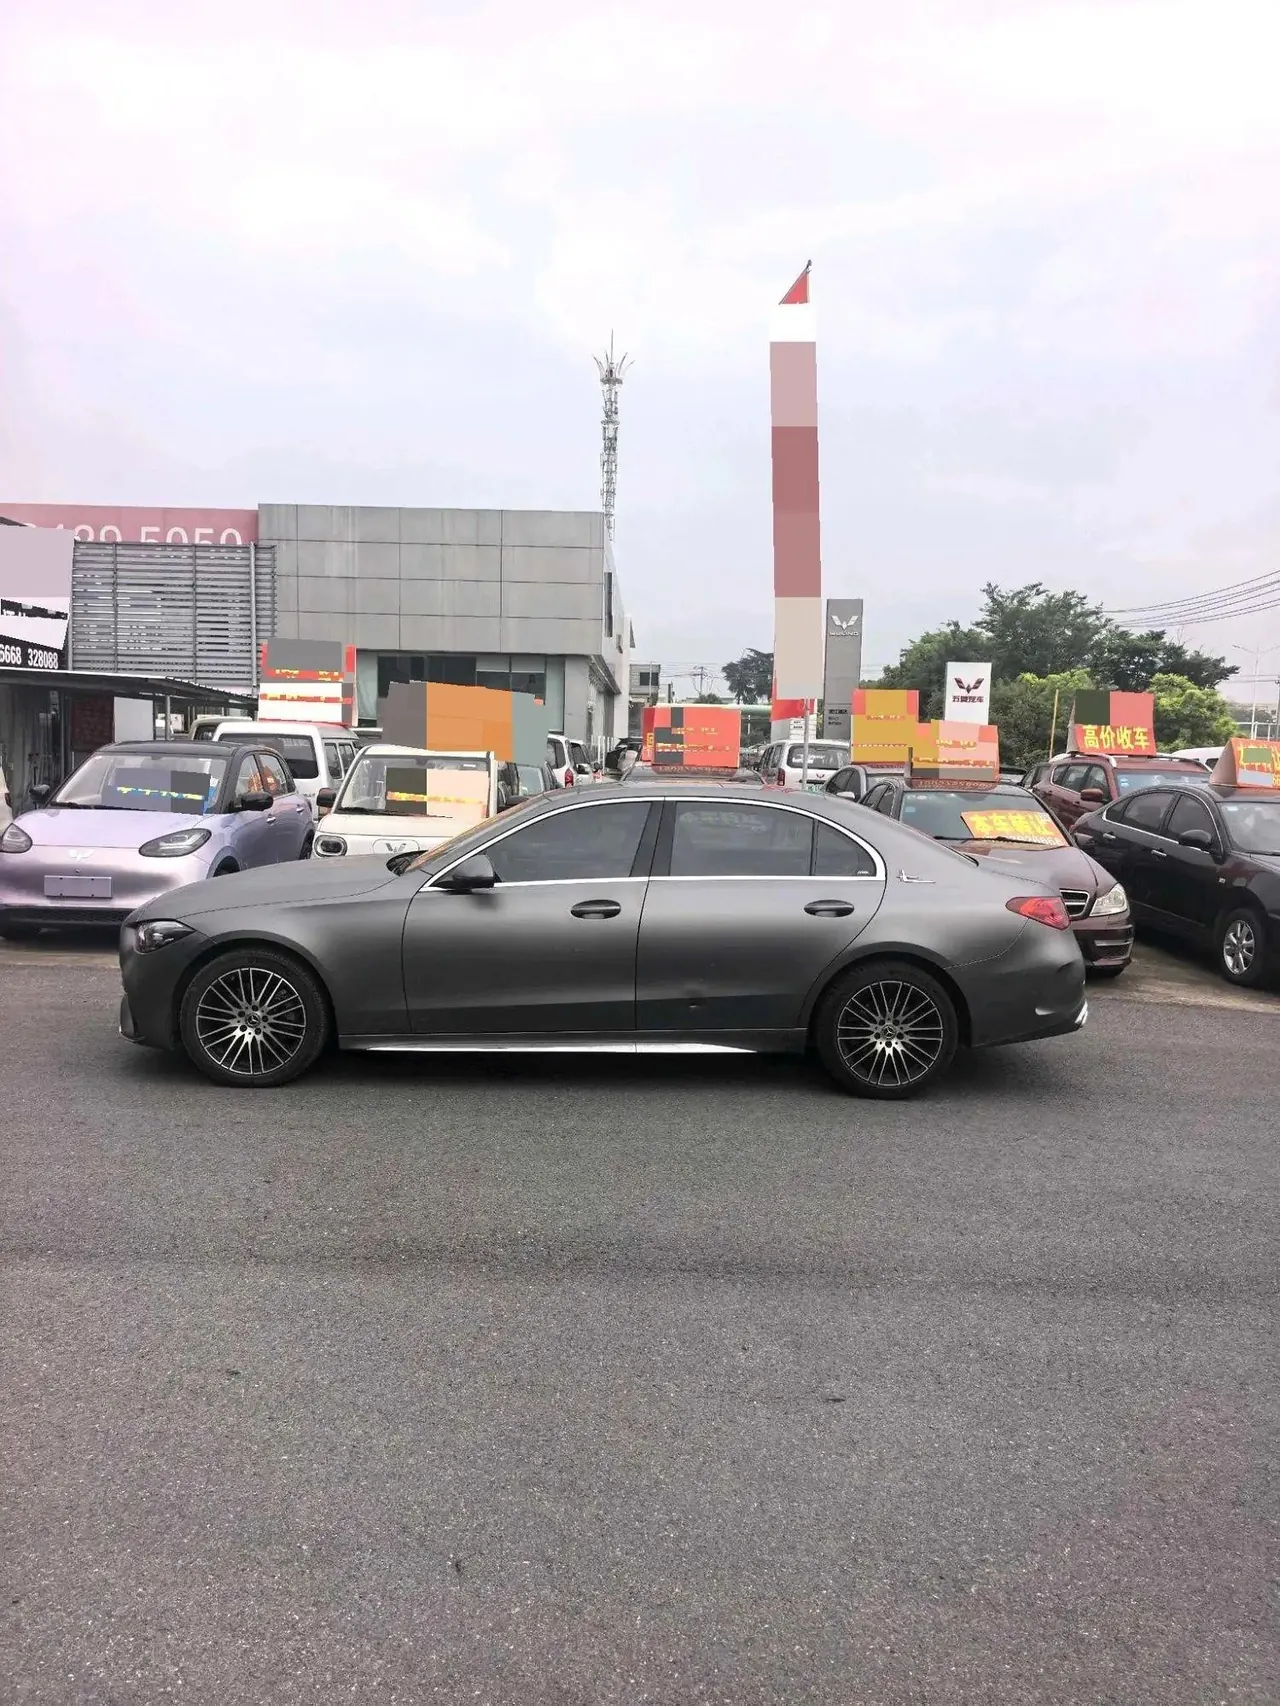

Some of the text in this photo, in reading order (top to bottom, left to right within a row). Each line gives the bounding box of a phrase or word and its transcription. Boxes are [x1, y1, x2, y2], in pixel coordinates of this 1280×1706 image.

[27, 648, 59, 670] 328088
[1082, 725, 1151, 751] 高价收车
